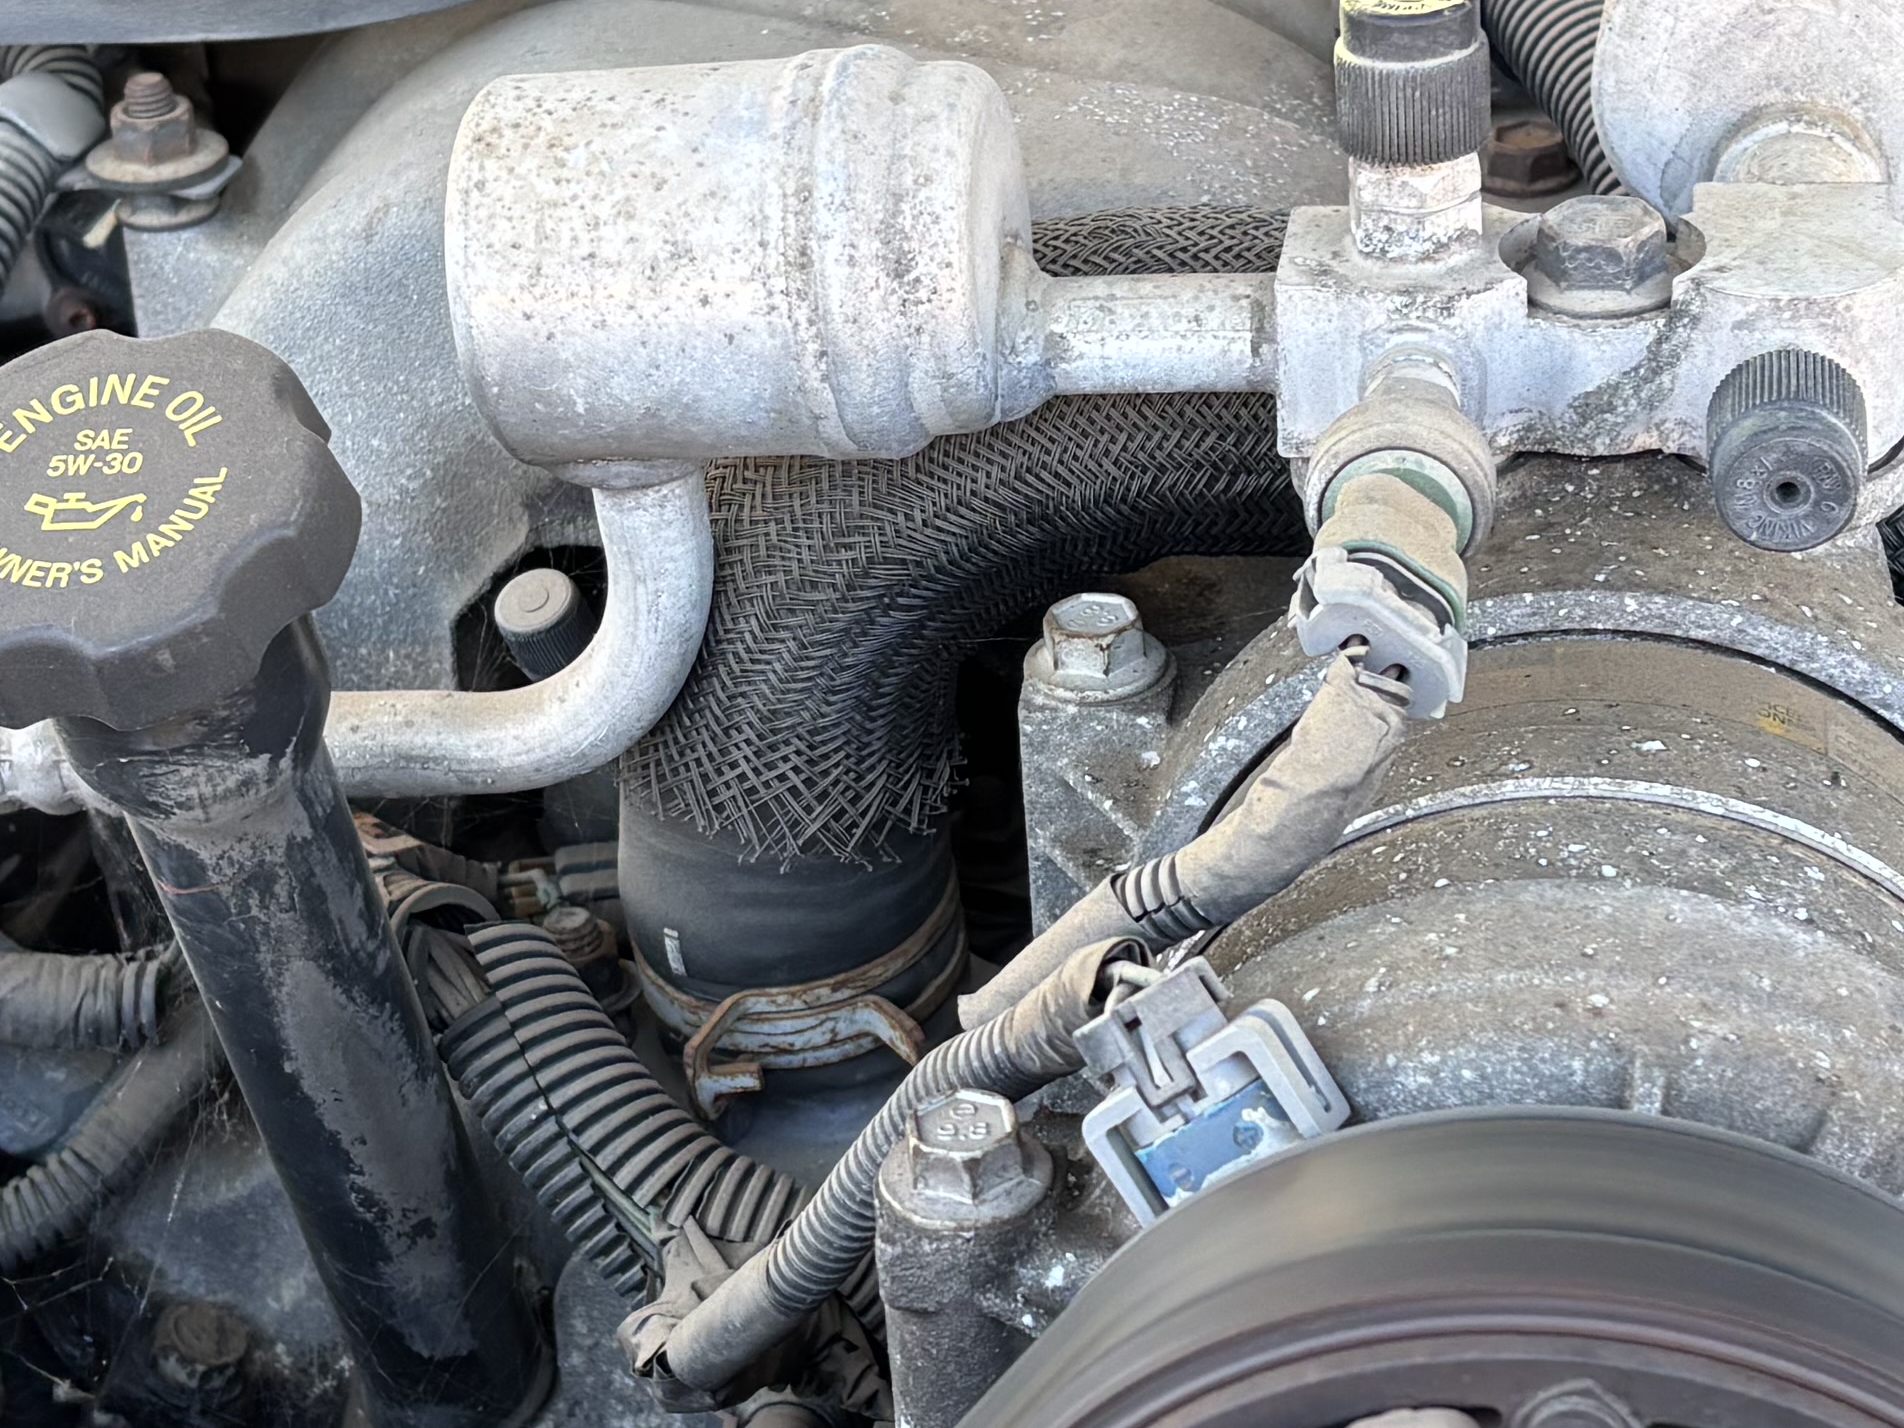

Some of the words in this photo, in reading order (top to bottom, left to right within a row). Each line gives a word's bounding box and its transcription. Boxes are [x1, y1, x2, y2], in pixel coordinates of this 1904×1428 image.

[74, 428, 134, 452] SAE
[164, 390, 223, 448] OIL
[46, 451, 144, 477] 5W-30
[113, 466, 228, 573] MANUAL
